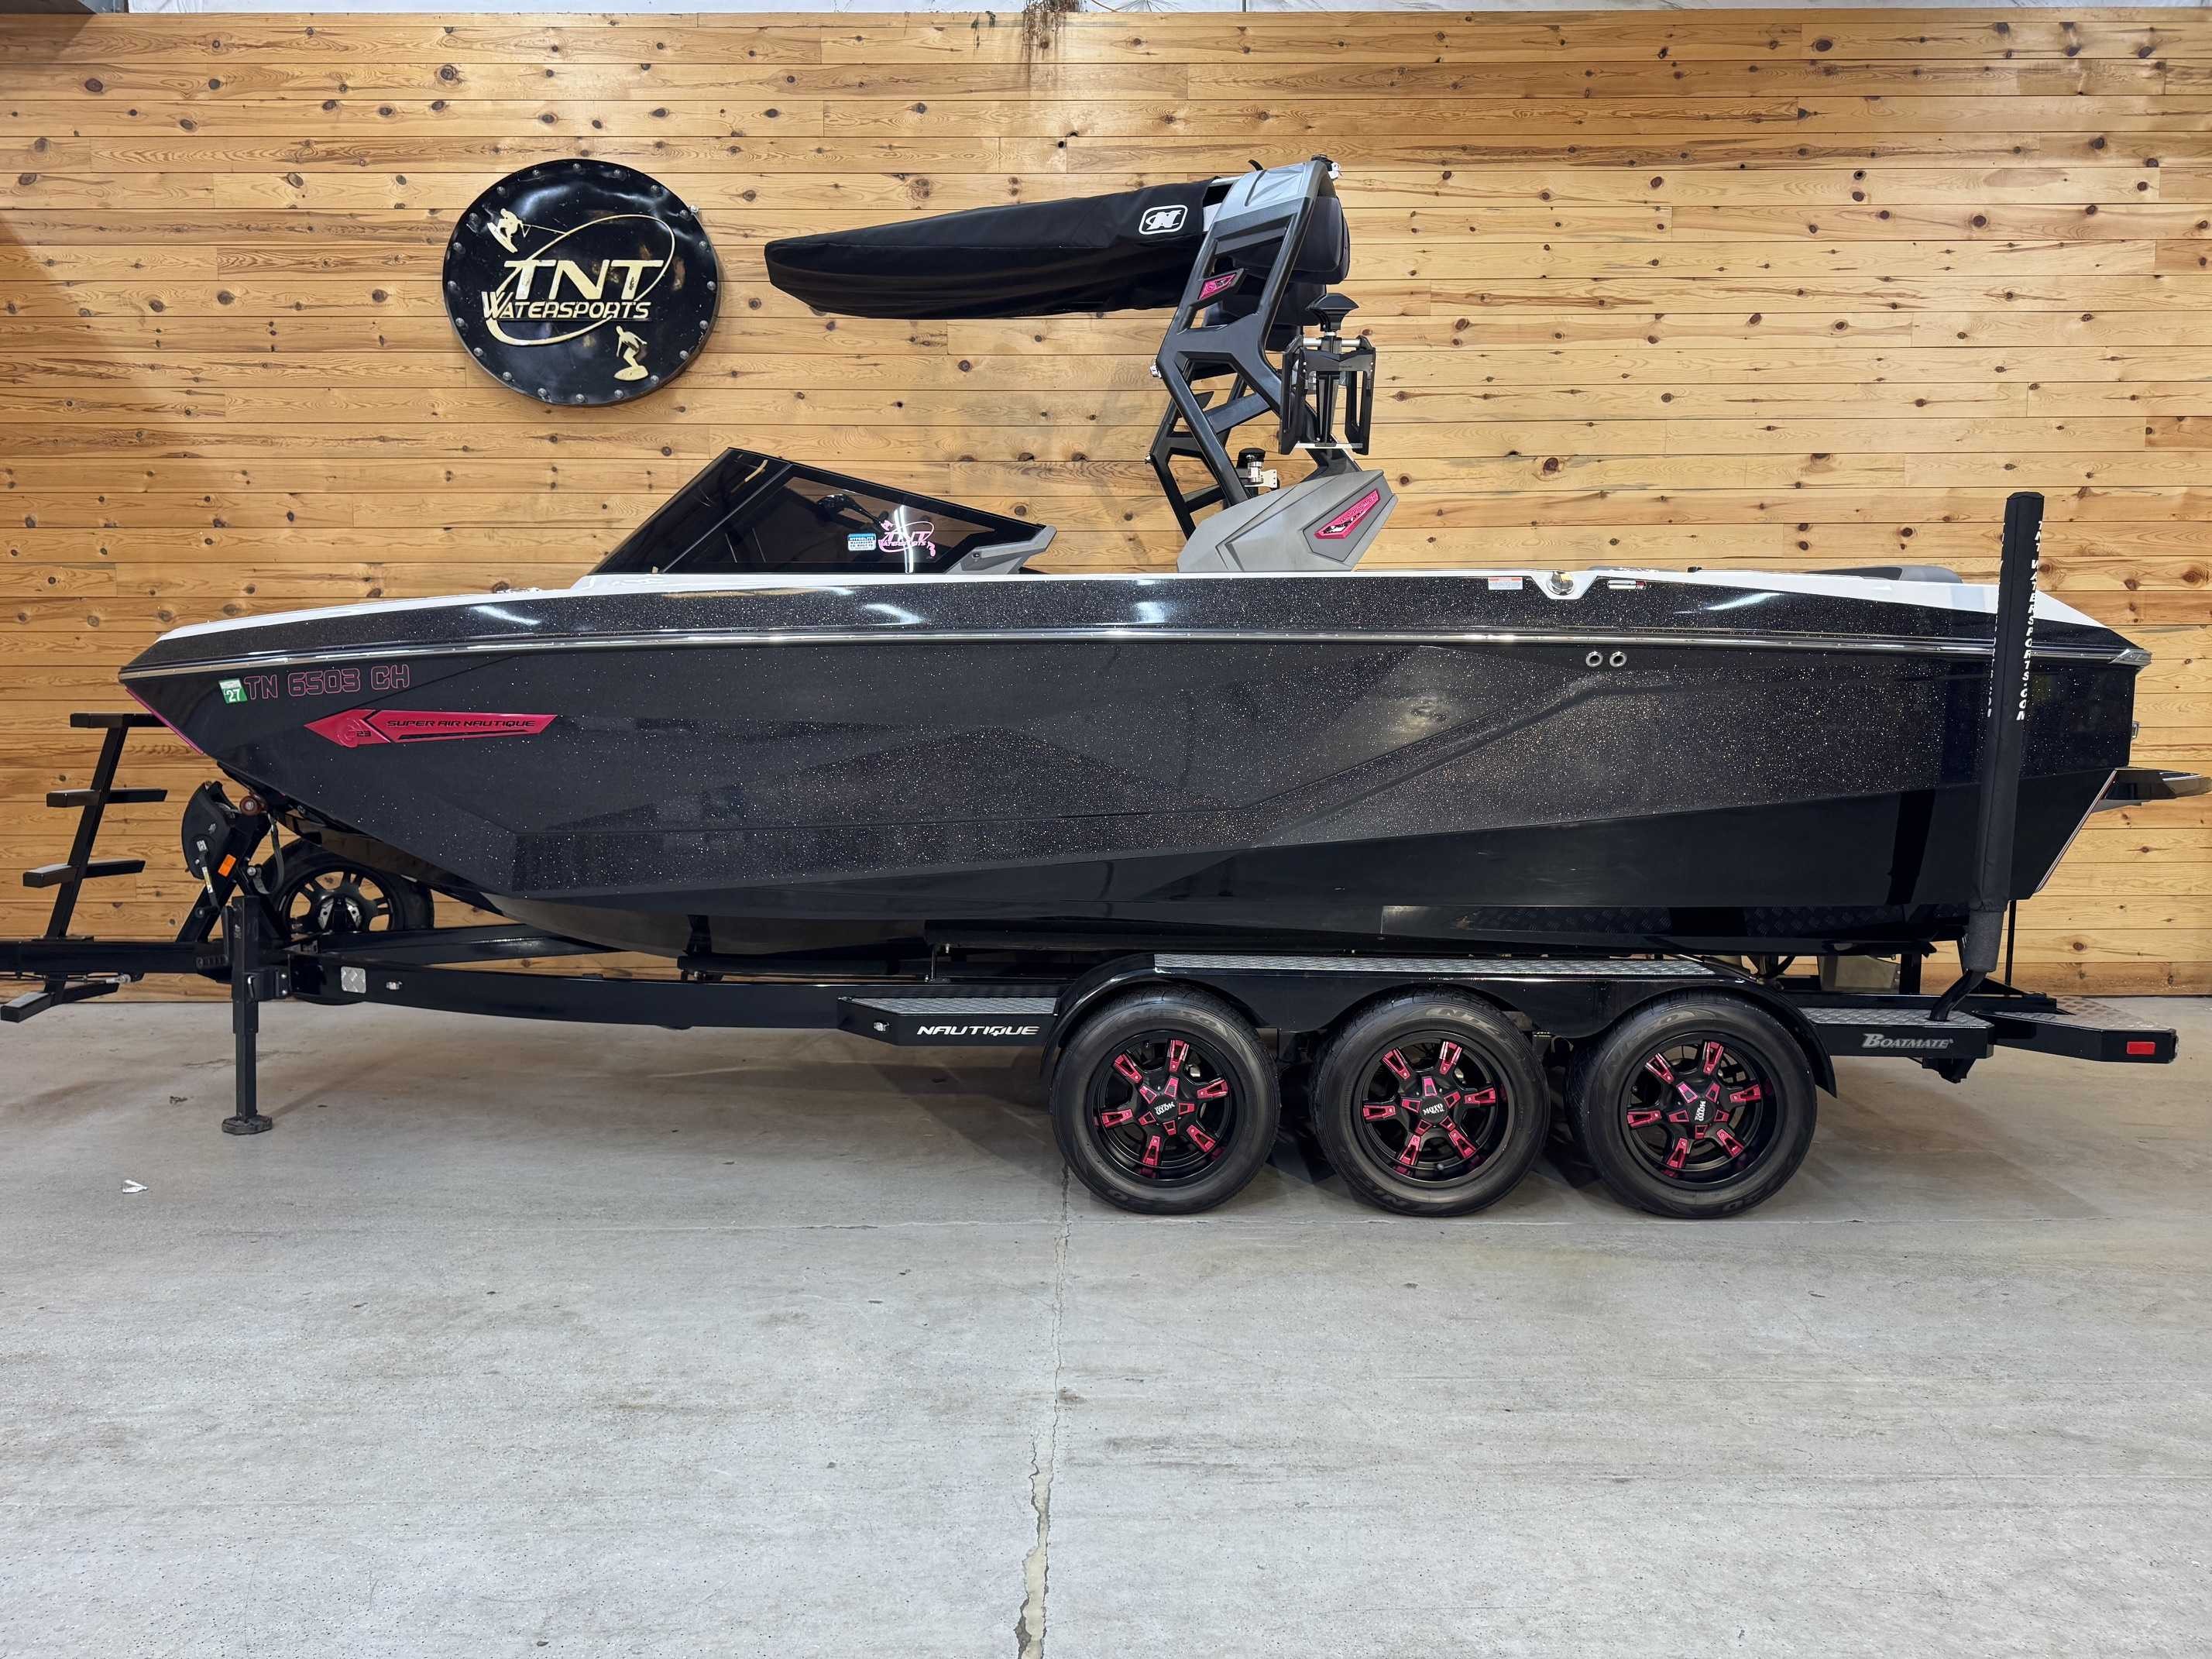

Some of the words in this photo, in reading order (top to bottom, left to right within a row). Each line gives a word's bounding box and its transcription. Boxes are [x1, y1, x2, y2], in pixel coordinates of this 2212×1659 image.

[503, 259, 664, 300] TNT
[481, 290, 651, 319] WATERSPORTS
[244, 675, 278, 700] TN
[287, 668, 361, 697] 6503
[370, 664, 410, 691] CH
[916, 1025, 1040, 1036] NAUTIQUE
